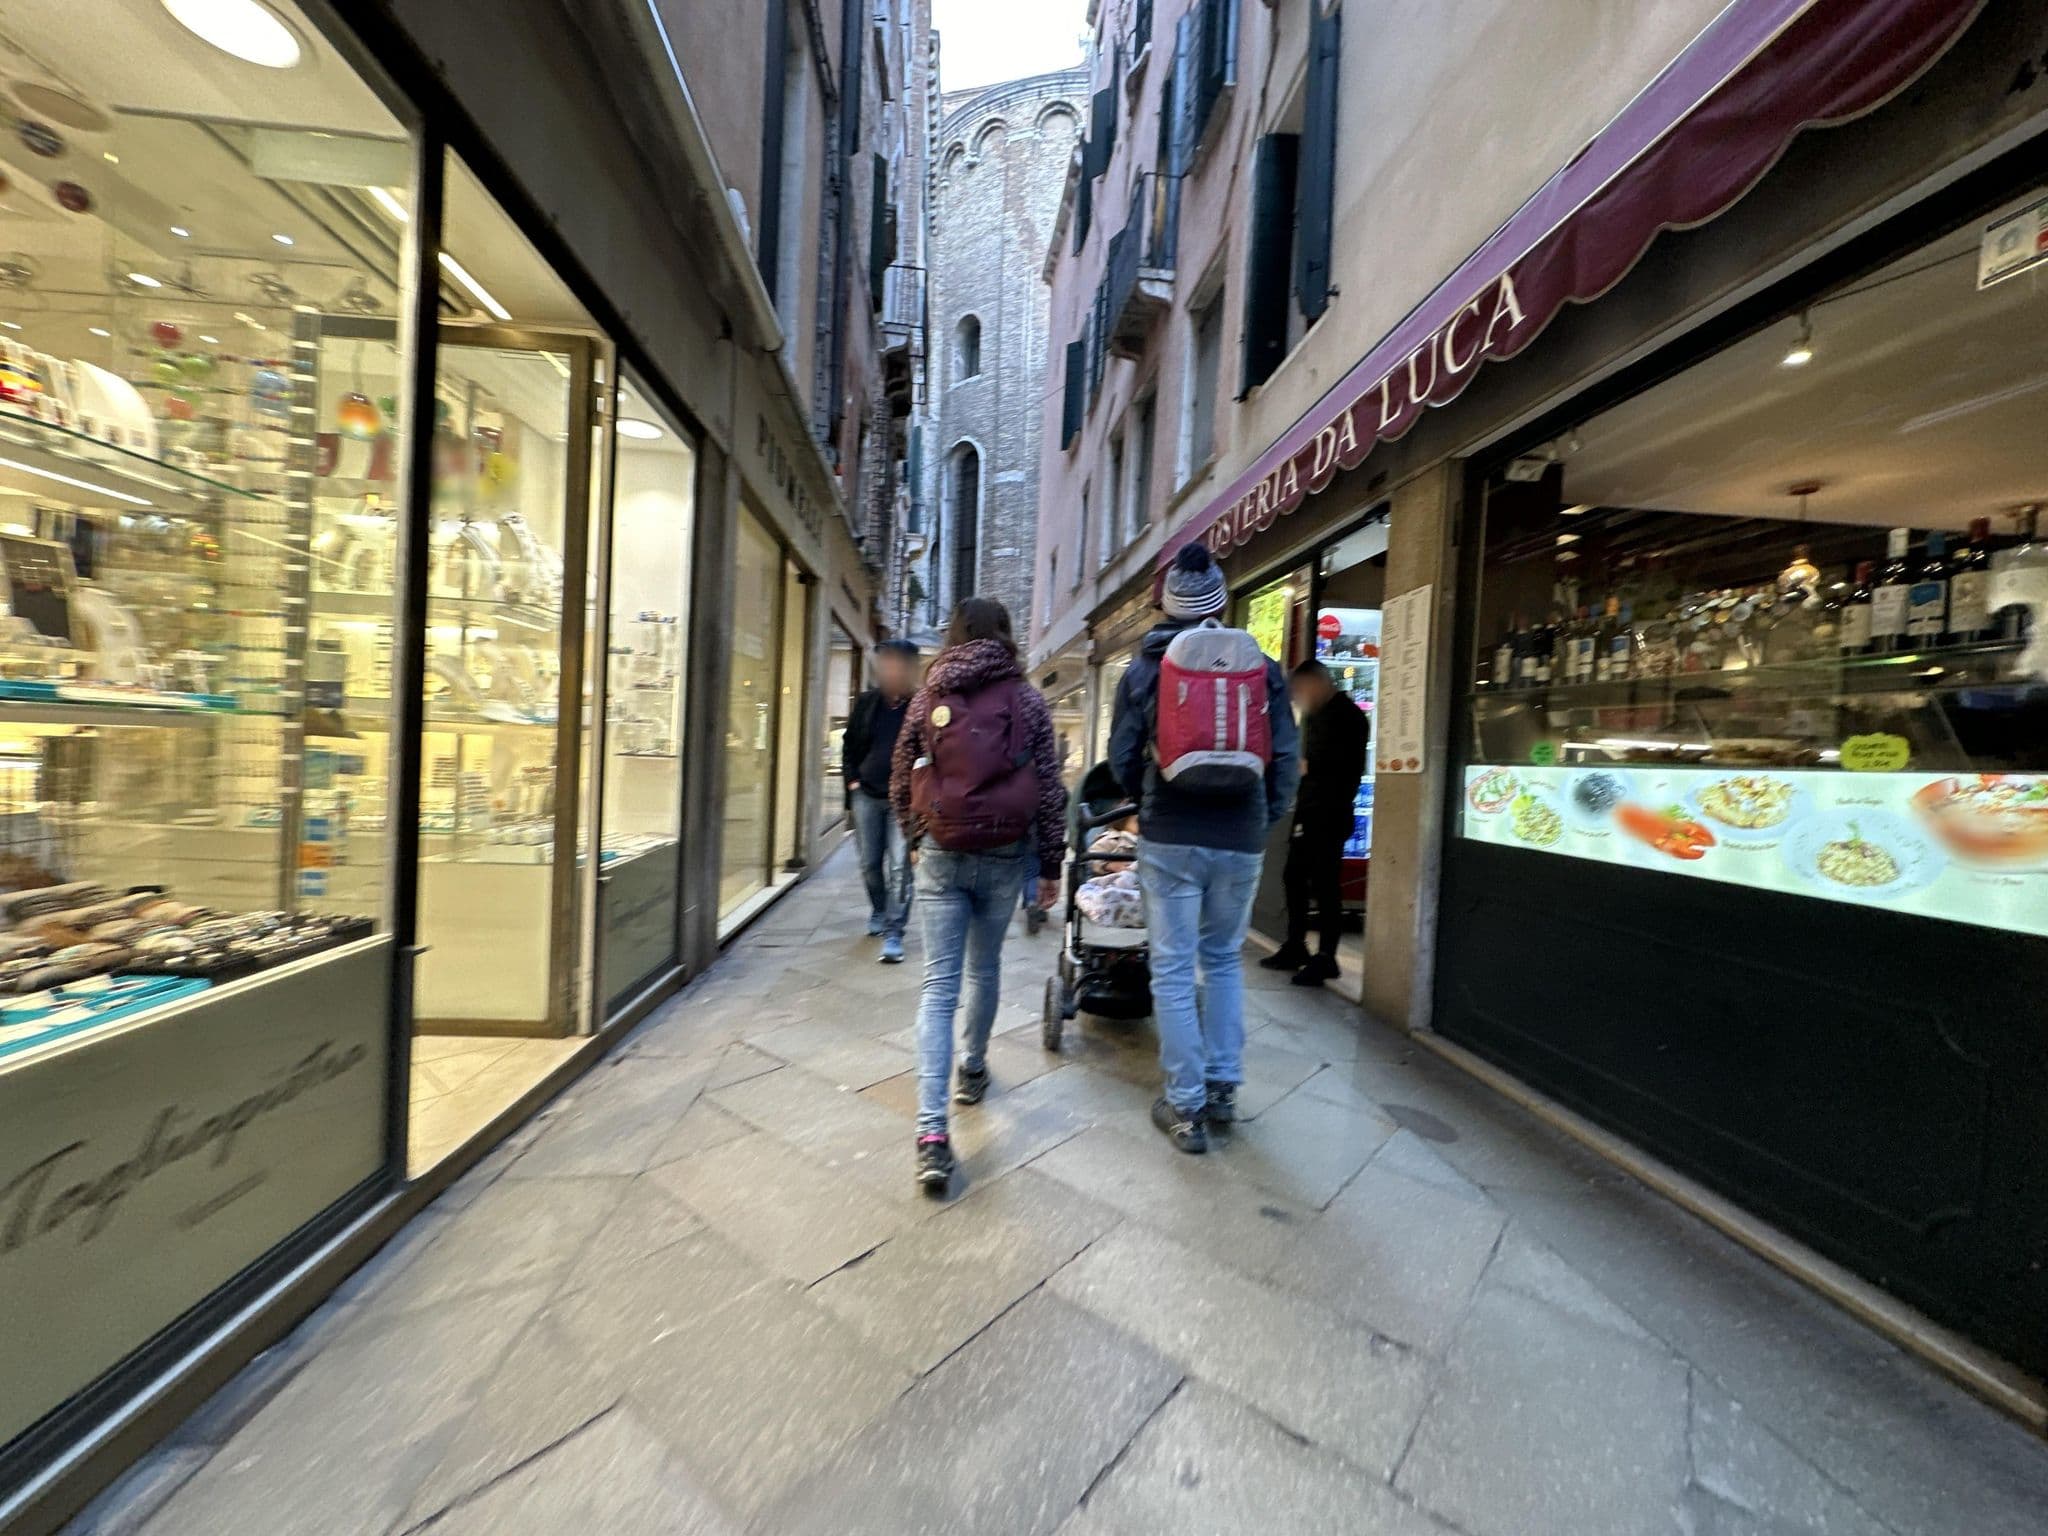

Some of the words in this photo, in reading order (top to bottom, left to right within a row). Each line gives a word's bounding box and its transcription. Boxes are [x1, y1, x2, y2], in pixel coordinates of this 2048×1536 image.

[1207, 456, 1299, 553] OSTERIA
[1311, 405, 1358, 480] DA
[1376, 271, 1527, 431] LUCA
